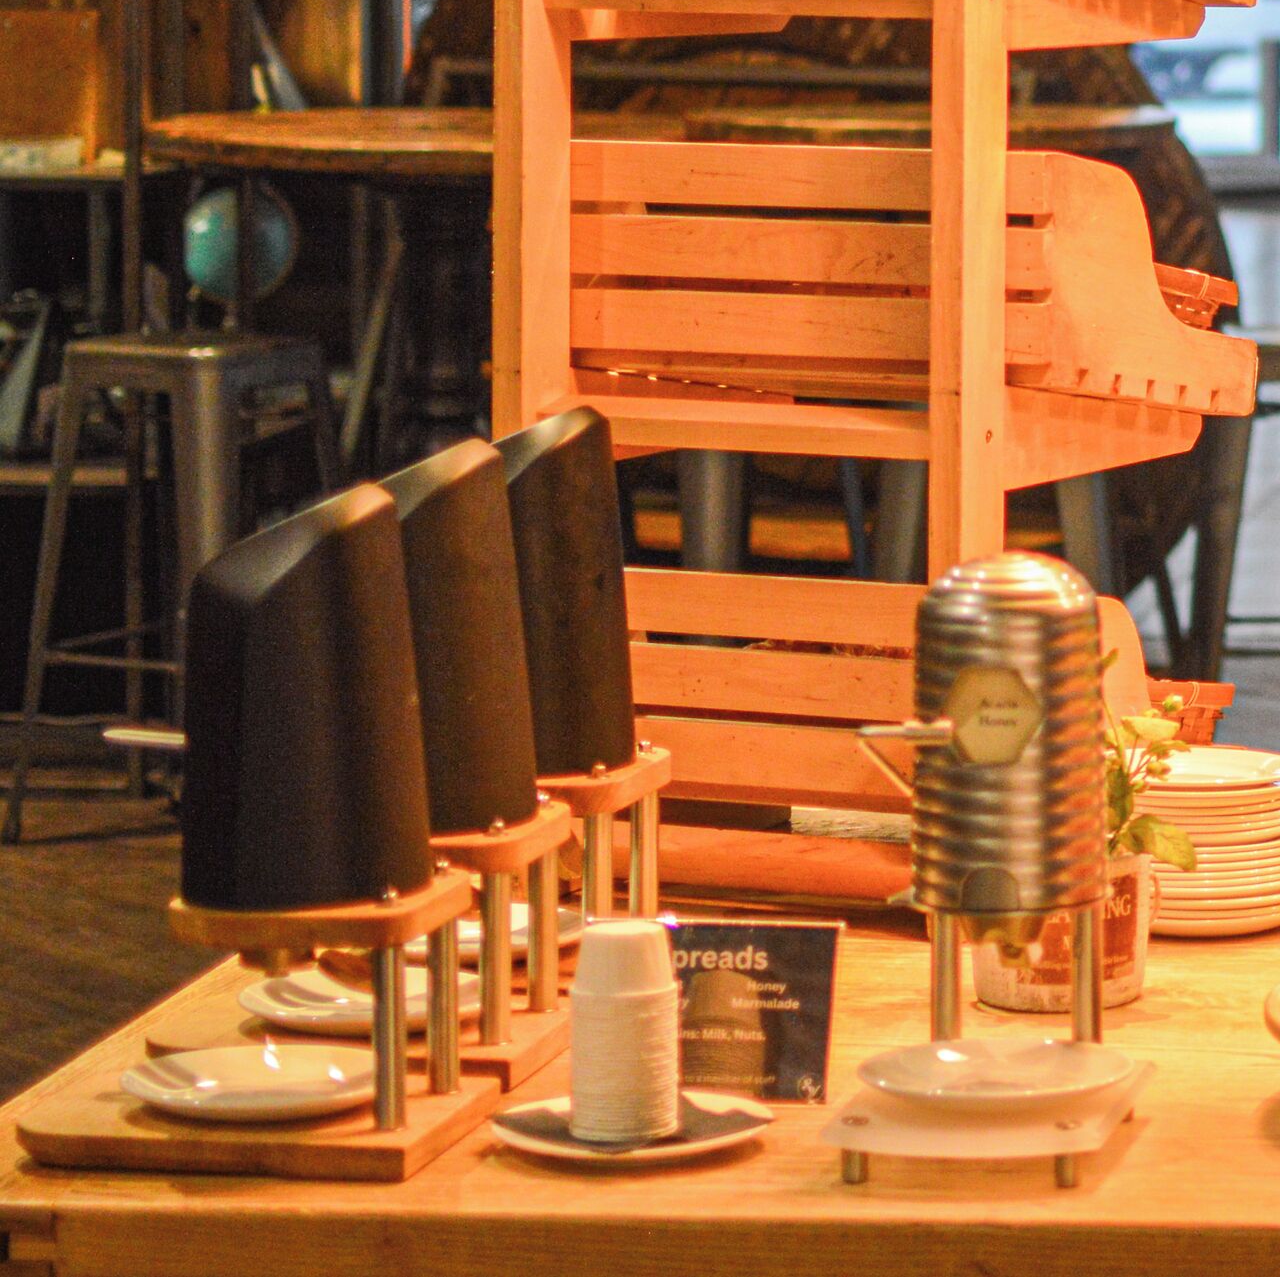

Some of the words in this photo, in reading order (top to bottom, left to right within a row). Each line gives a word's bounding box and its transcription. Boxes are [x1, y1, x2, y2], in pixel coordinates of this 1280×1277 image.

[672, 945, 769, 970] preads
[747, 980, 787, 994] Honey
[731, 997, 800, 1010] Marmalade
